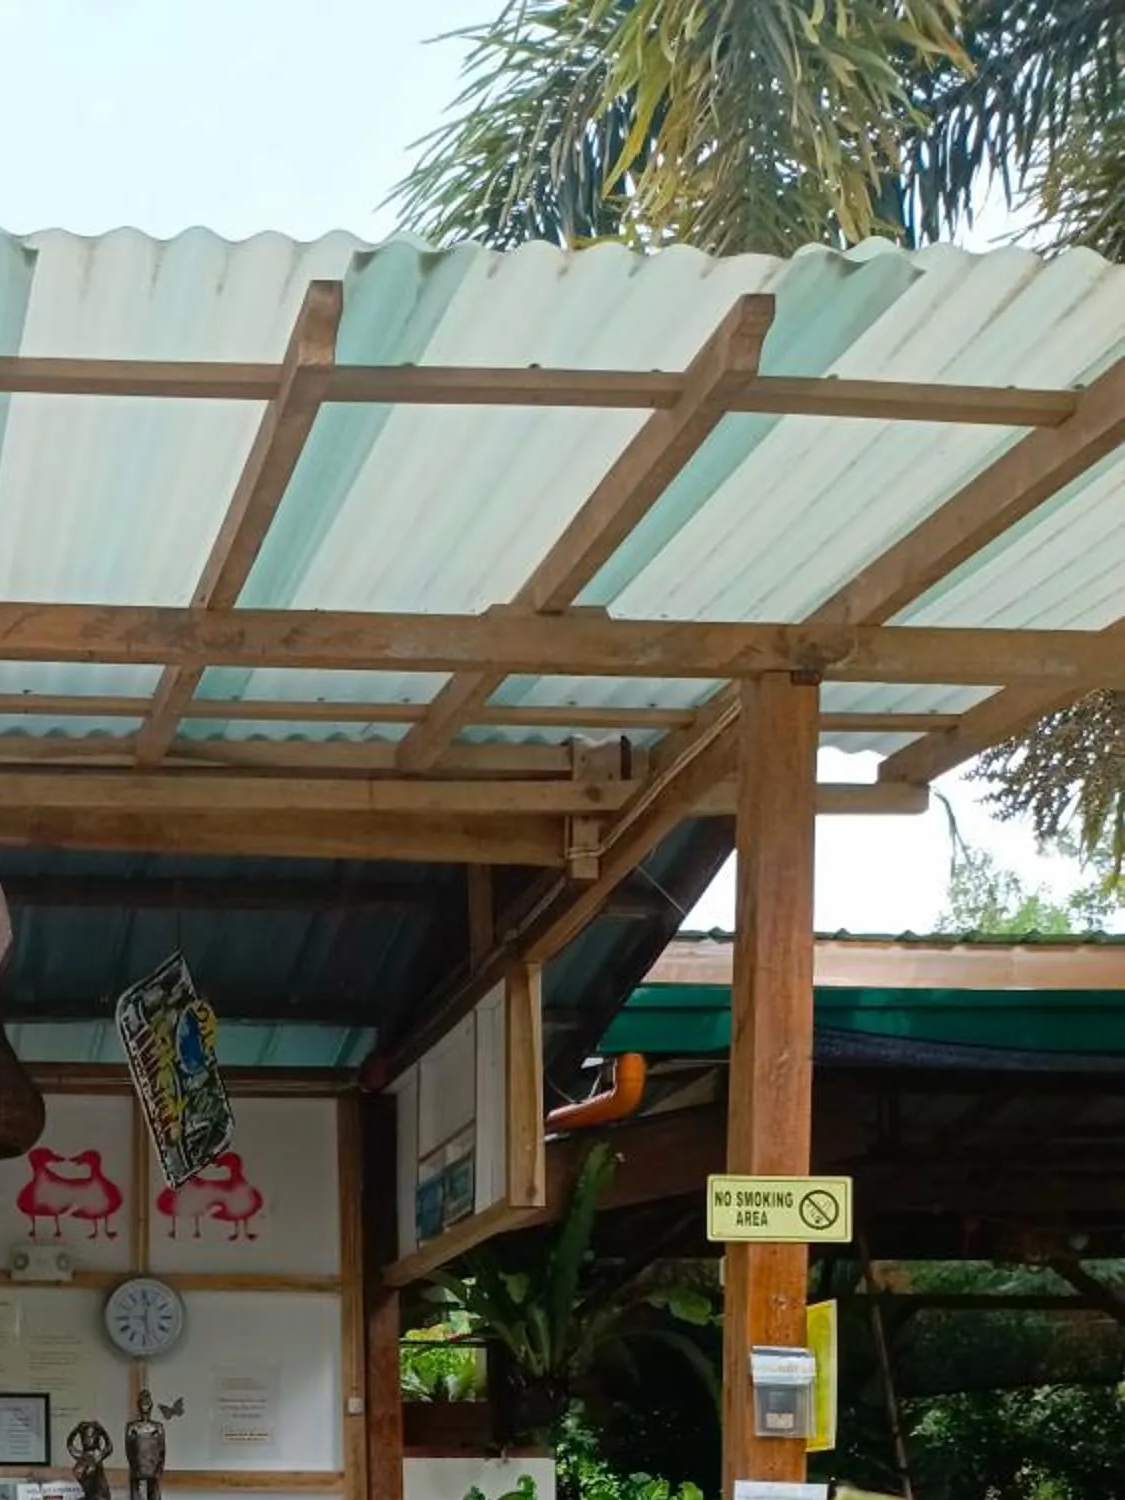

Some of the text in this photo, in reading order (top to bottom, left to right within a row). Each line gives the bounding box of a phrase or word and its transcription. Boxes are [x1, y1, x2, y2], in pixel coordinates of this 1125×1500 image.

[715, 1191, 794, 1208] NO SMOKING
[736, 1211, 768, 1226] AREA
